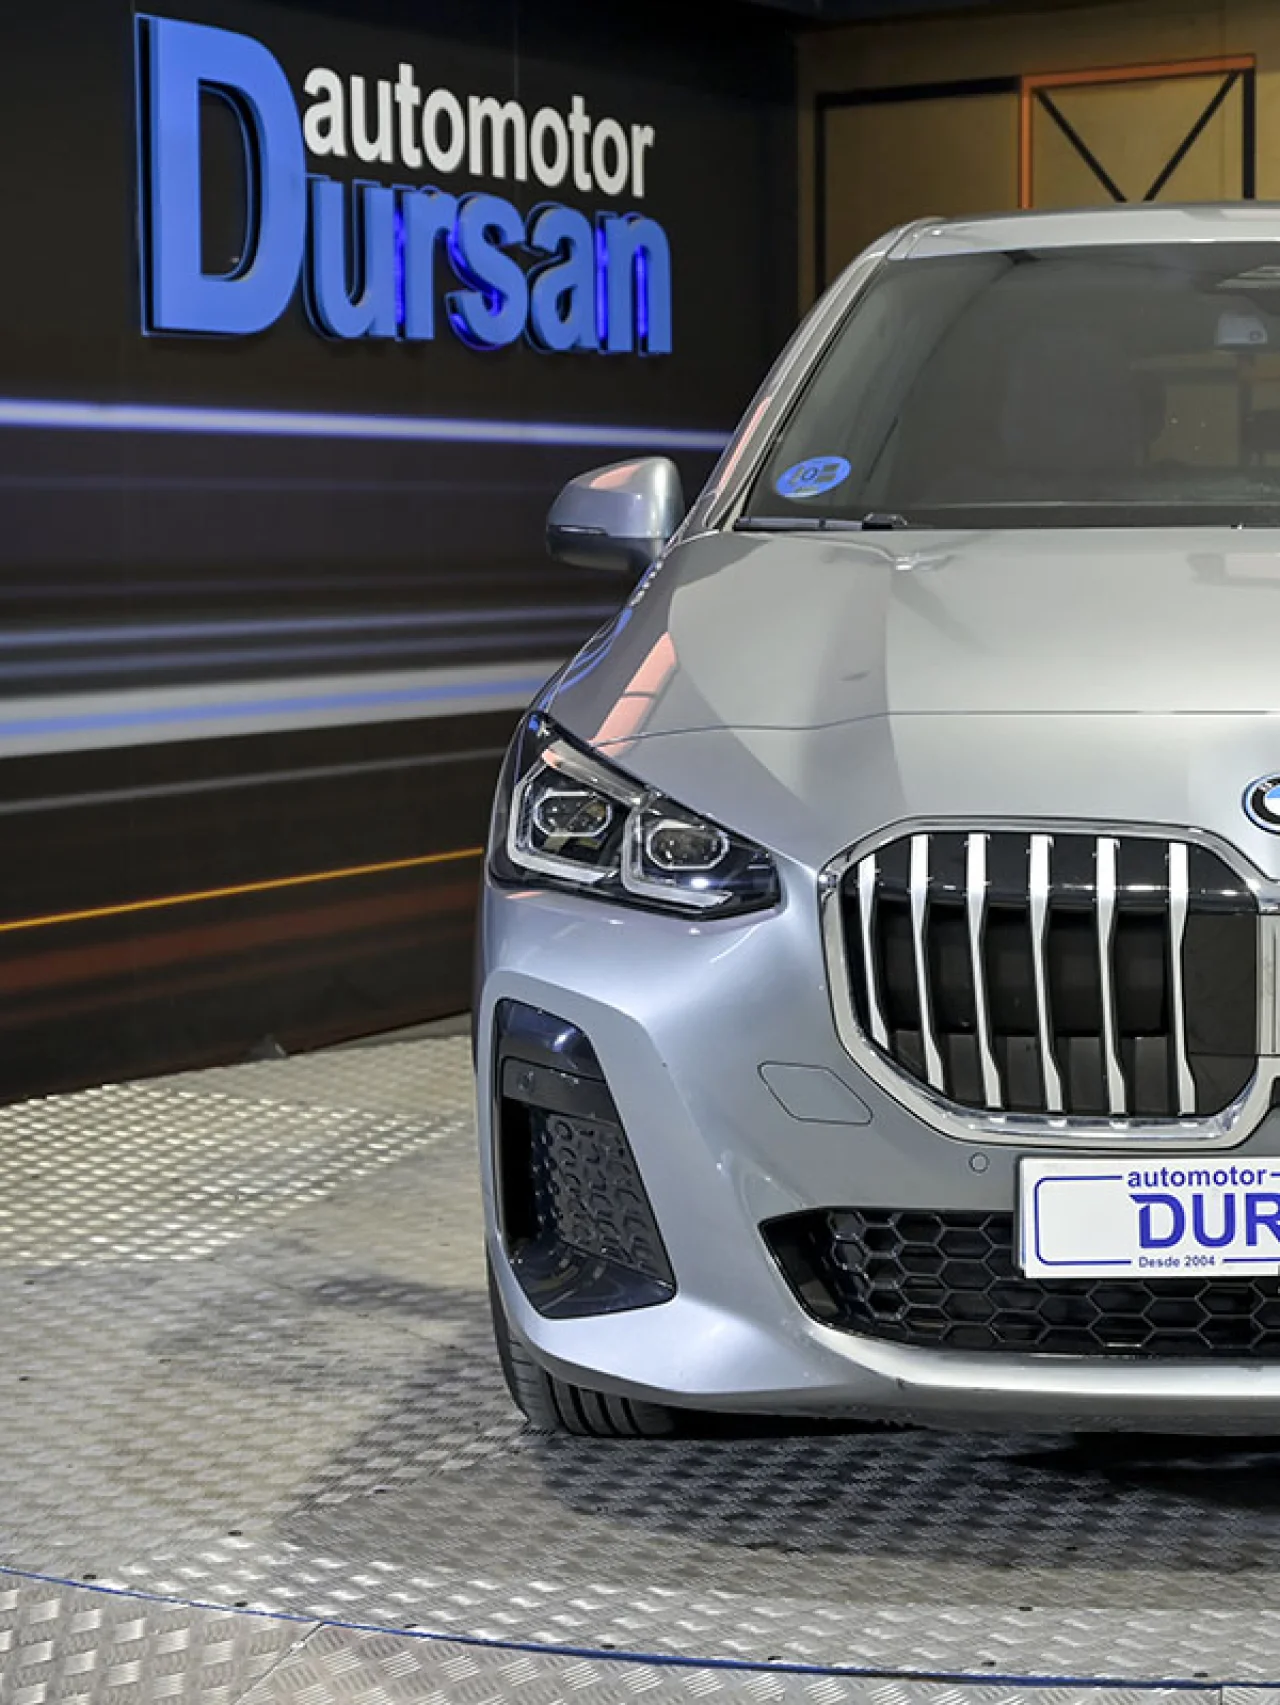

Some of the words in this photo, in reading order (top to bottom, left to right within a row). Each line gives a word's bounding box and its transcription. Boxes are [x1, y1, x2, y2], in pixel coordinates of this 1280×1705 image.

[303, 63, 655, 198] automotor
[134, 13, 672, 356] Dursan
[1127, 1165, 1268, 1188] automotor
[1138, 1256, 1181, 1268] Desde
[1183, 1254, 1216, 1267] 2004
